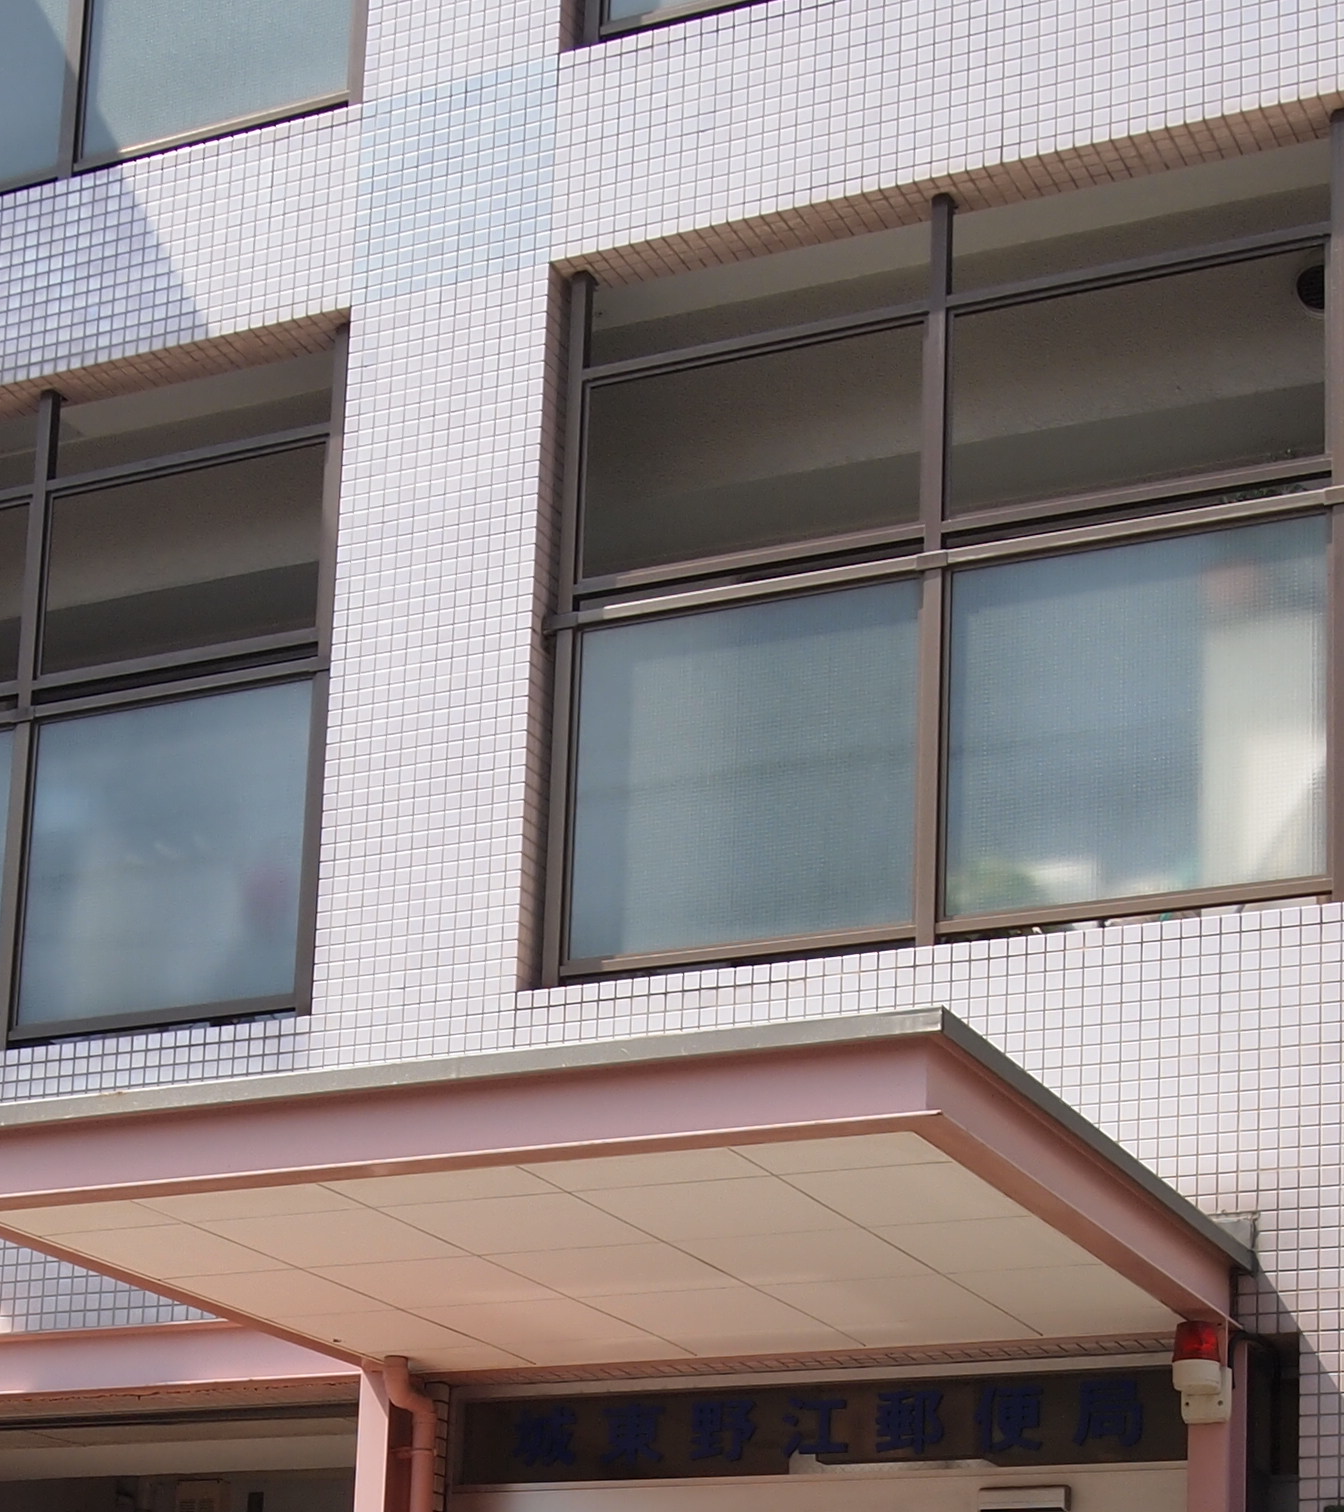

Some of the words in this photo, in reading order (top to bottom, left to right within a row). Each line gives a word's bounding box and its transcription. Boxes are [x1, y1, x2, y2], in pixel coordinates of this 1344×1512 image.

[513, 1379, 1146, 1468] 城東野江郵便局
